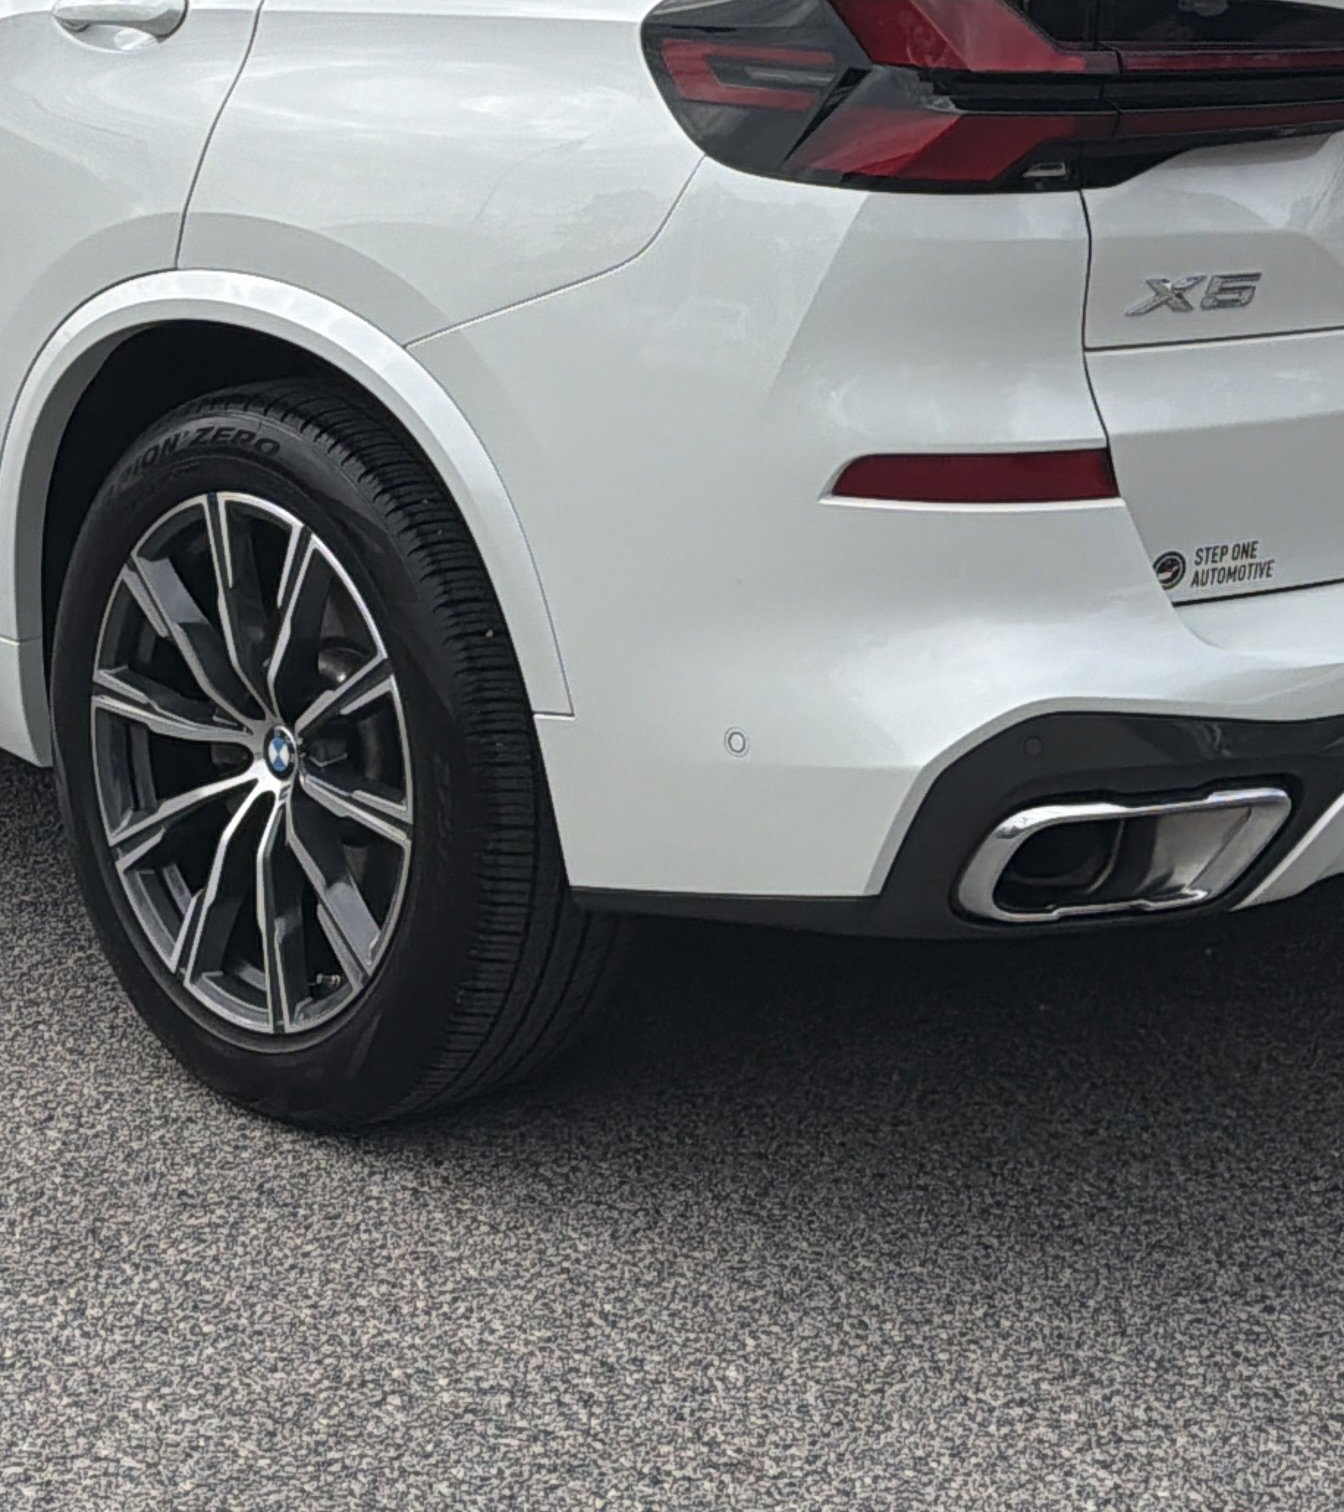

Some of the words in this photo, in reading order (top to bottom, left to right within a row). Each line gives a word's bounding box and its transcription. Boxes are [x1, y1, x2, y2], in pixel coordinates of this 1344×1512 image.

[1123, 271, 1263, 318] X5
[190, 425, 281, 456] ZERO
[1193, 545, 1229, 566] STEP
[1231, 540, 1259, 561] ONE
[1190, 559, 1276, 588] AUTOMOTIVE
